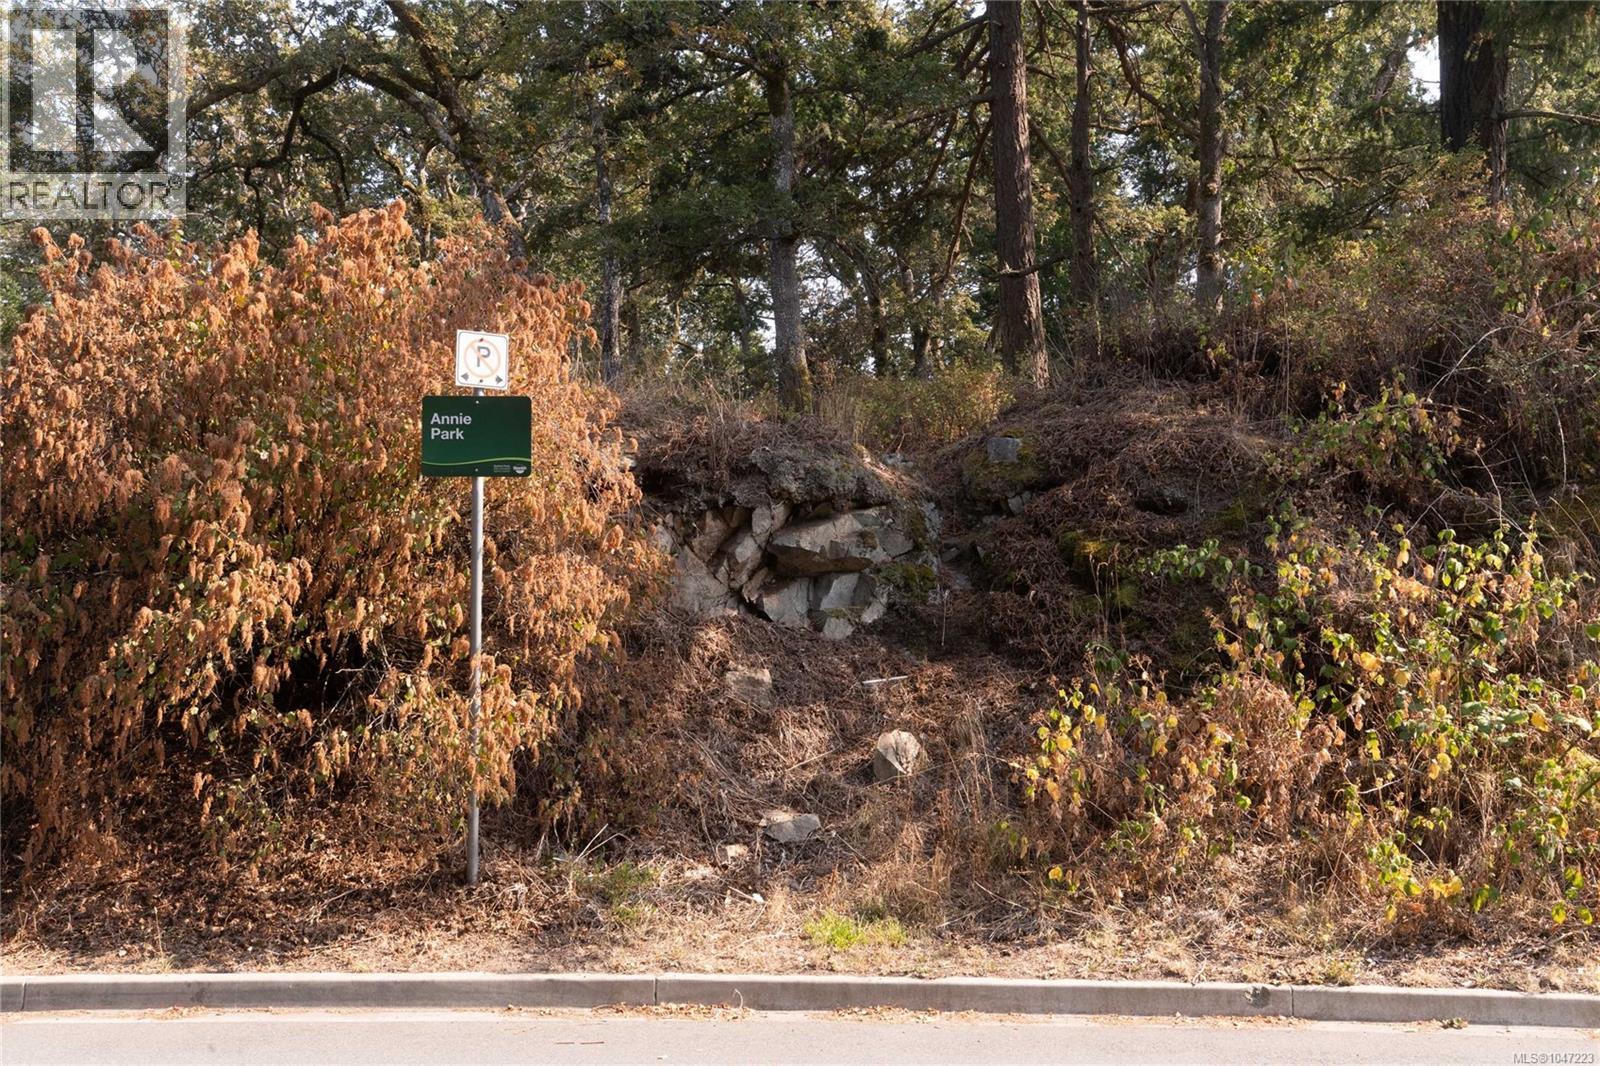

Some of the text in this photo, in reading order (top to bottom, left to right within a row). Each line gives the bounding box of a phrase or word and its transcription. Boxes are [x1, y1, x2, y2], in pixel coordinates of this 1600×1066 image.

[477, 345, 491, 367] P
[430, 412, 472, 425] Annie
[430, 427, 464, 440] Park
